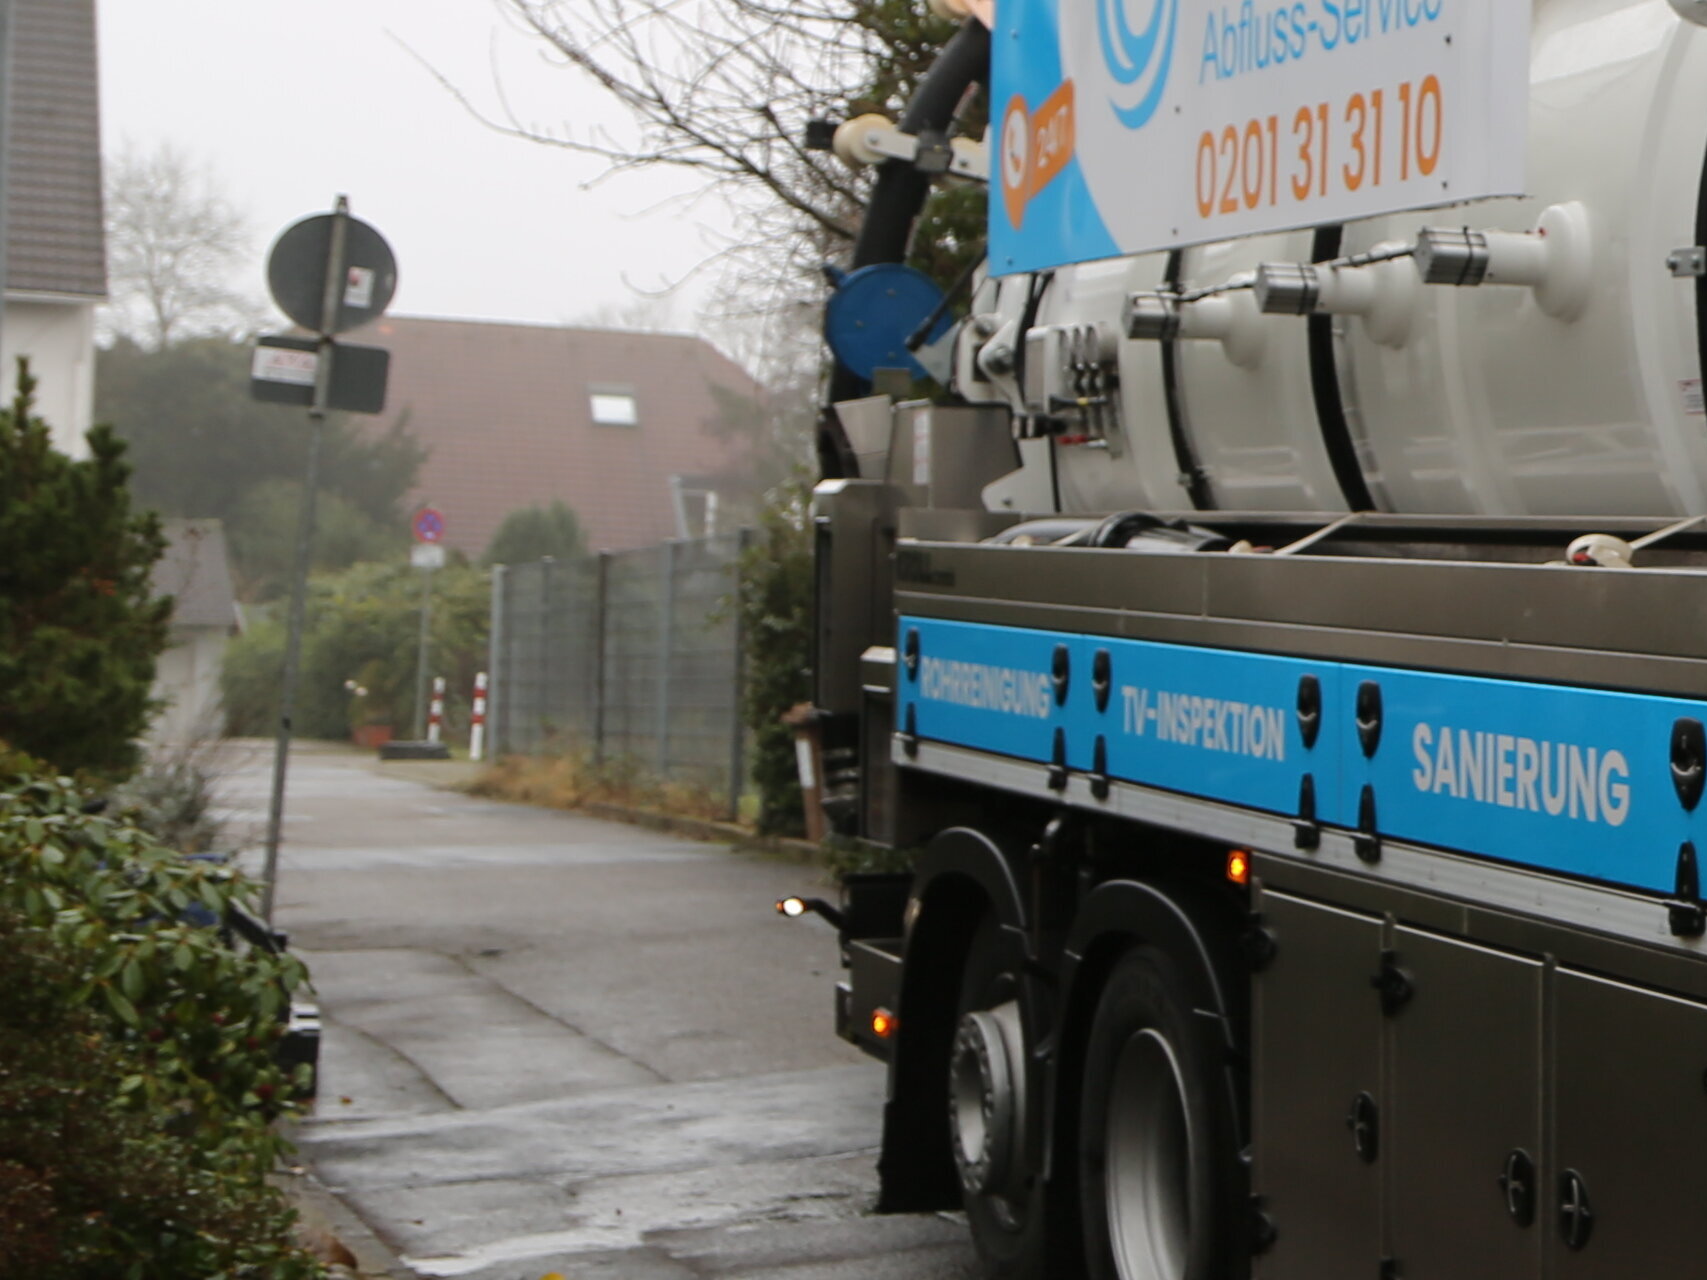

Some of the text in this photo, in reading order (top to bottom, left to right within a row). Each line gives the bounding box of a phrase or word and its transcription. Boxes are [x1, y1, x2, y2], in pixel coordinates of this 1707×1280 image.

[1195, 74, 1442, 219] 0201 31 31 10
[919, 654, 1051, 719] ROHRREINIGUNG
[1121, 685, 1285, 762] TV-INSPEKTION
[1412, 722, 1631, 828] SANIERUNG
